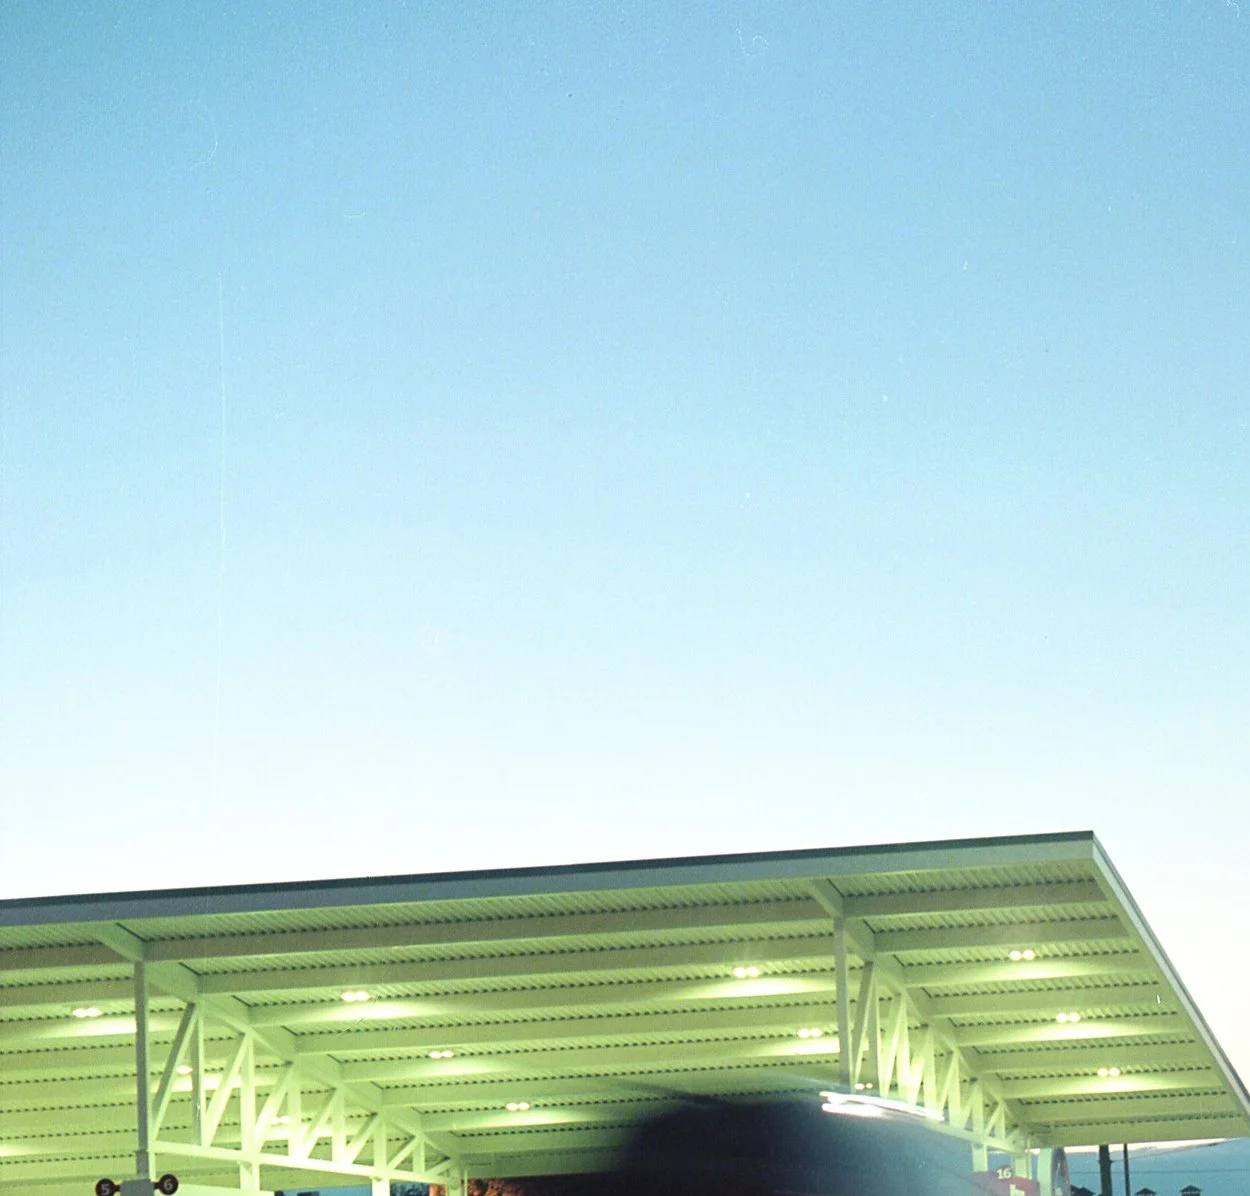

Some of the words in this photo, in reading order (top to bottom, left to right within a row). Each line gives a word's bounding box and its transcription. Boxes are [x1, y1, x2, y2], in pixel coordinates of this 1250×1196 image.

[996, 1167, 1012, 1179] 16
[101, 1183, 110, 1196] 5
[163, 1178, 173, 1191] 6
